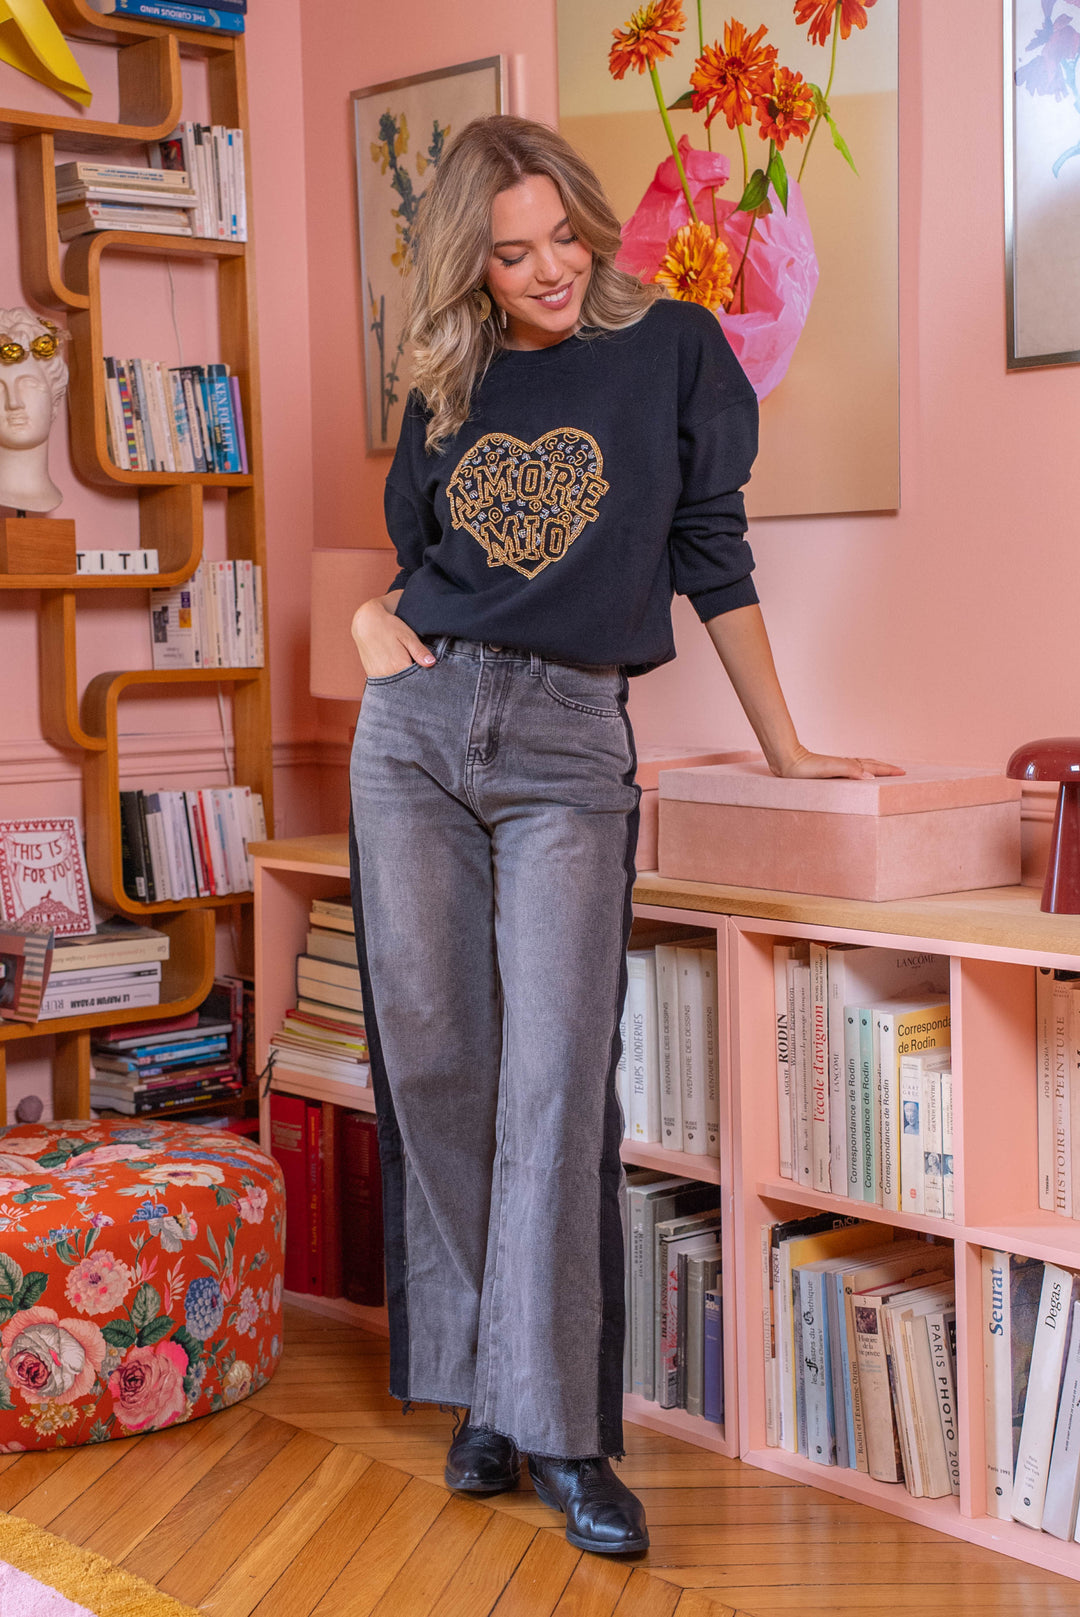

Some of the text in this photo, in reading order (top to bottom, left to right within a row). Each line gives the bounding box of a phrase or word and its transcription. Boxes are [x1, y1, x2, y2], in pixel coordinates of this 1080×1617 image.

[140, 5, 160, 15] MIND
[161, 9, 191, 20] CURIOUS
[192, 13, 206, 22] THE
[215, 382, 234, 454] KEN FOLLETT
[446, 460, 610, 530] AMORE
[76, 552, 148, 570] TITI
[480, 515, 571, 568] MIO
[12, 839, 62, 860] THIS IS
[22, 857, 72, 884] FOR YOU
[70, 998, 95, 1008] D'ADAM
[96, 994, 121, 1005] PARFUM
[122, 994, 130, 1002] LE
[633, 1014, 644, 1095] TEMPS MODERNES
[777, 1014, 788, 1064] RODIN
[898, 1036, 936, 1053] de Rodin
[1055, 1016, 1064, 1099] PEINTURE
[813, 1005, 826, 1122] l'école d'avignon
[862, 1092, 870, 1105] de
[883, 1108, 890, 1119] de
[848, 1059, 858, 1184] Correspondance de Rodin
[863, 1108, 872, 1188] Correspondance
[1056, 1128, 1066, 1210] HISTOIRE
[803, 1280, 814, 1325] Gothique
[989, 1267, 1004, 1336] Seurat
[1044, 1282, 1061, 1330] Degas
[809, 1328, 815, 1339] du
[931, 1324, 960, 1486] PARIS PHOTO 2003
